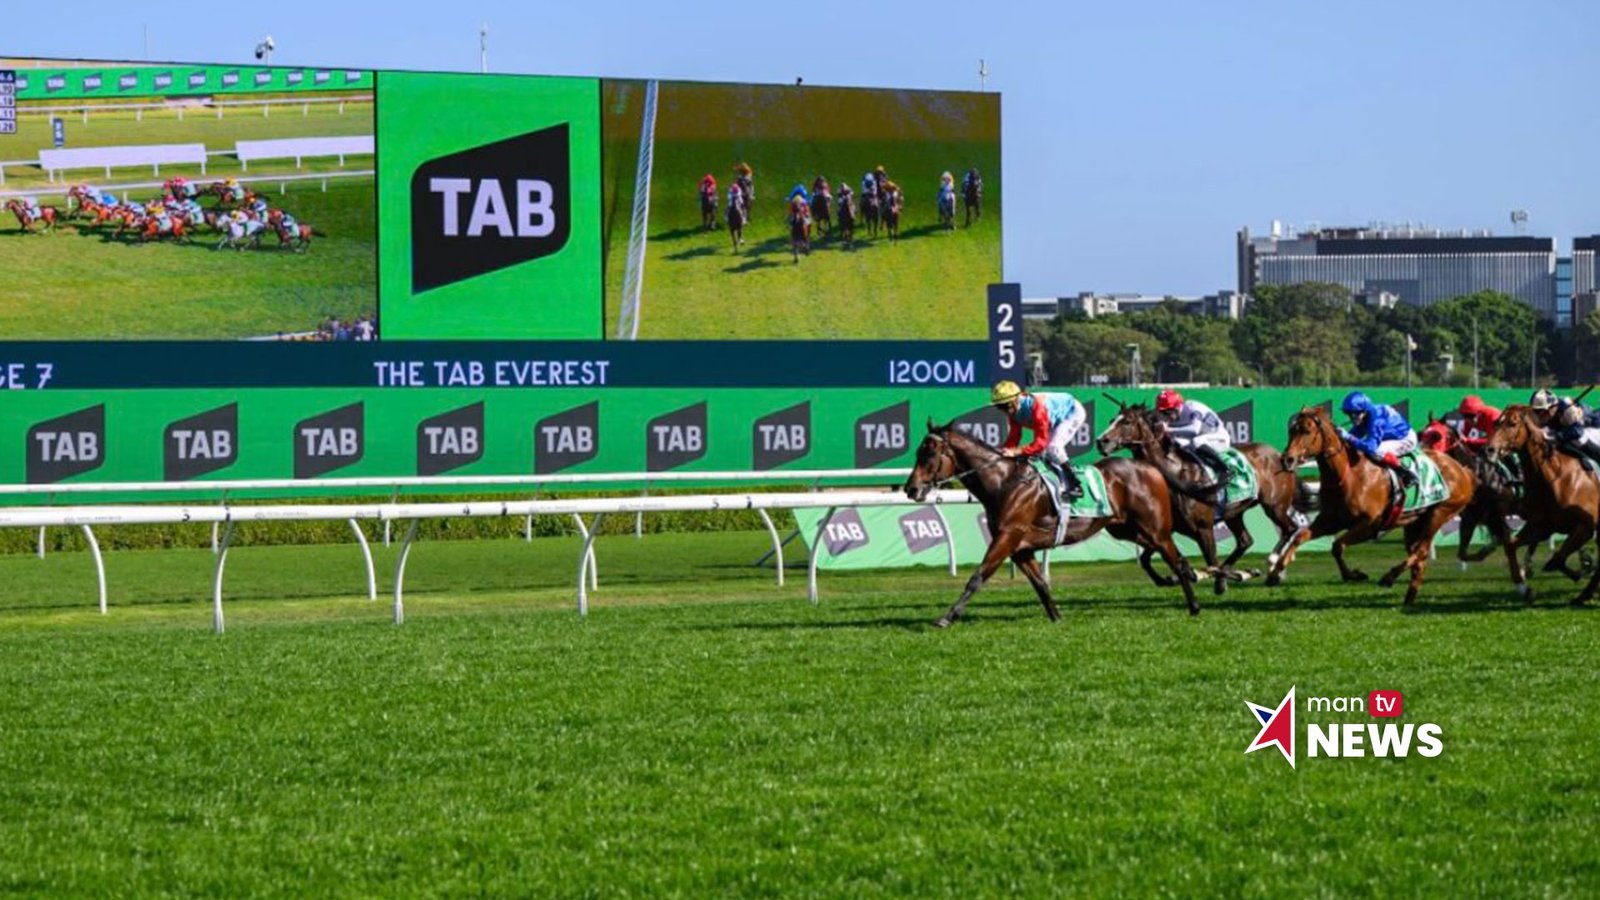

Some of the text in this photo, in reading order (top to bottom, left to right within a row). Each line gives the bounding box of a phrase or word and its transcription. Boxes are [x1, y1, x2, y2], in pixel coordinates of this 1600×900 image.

[430, 178, 555, 237] TAB
[36, 363, 53, 388] 7
[374, 360, 609, 386] THE TAB EVEREST
[889, 359, 974, 383] 1200M
[173, 430, 231, 459] TAB
[301, 428, 357, 456] TAB
[424, 426, 478, 454] TAB
[541, 425, 593, 453] TAB
[653, 425, 702, 451] TAB
[759, 424, 806, 450] TAB
[861, 423, 905, 449] TAB
[1225, 421, 1249, 443] AB
[36, 432, 98, 461] TAB
[826, 522, 865, 542] TAB
[903, 520, 945, 540] TAB
